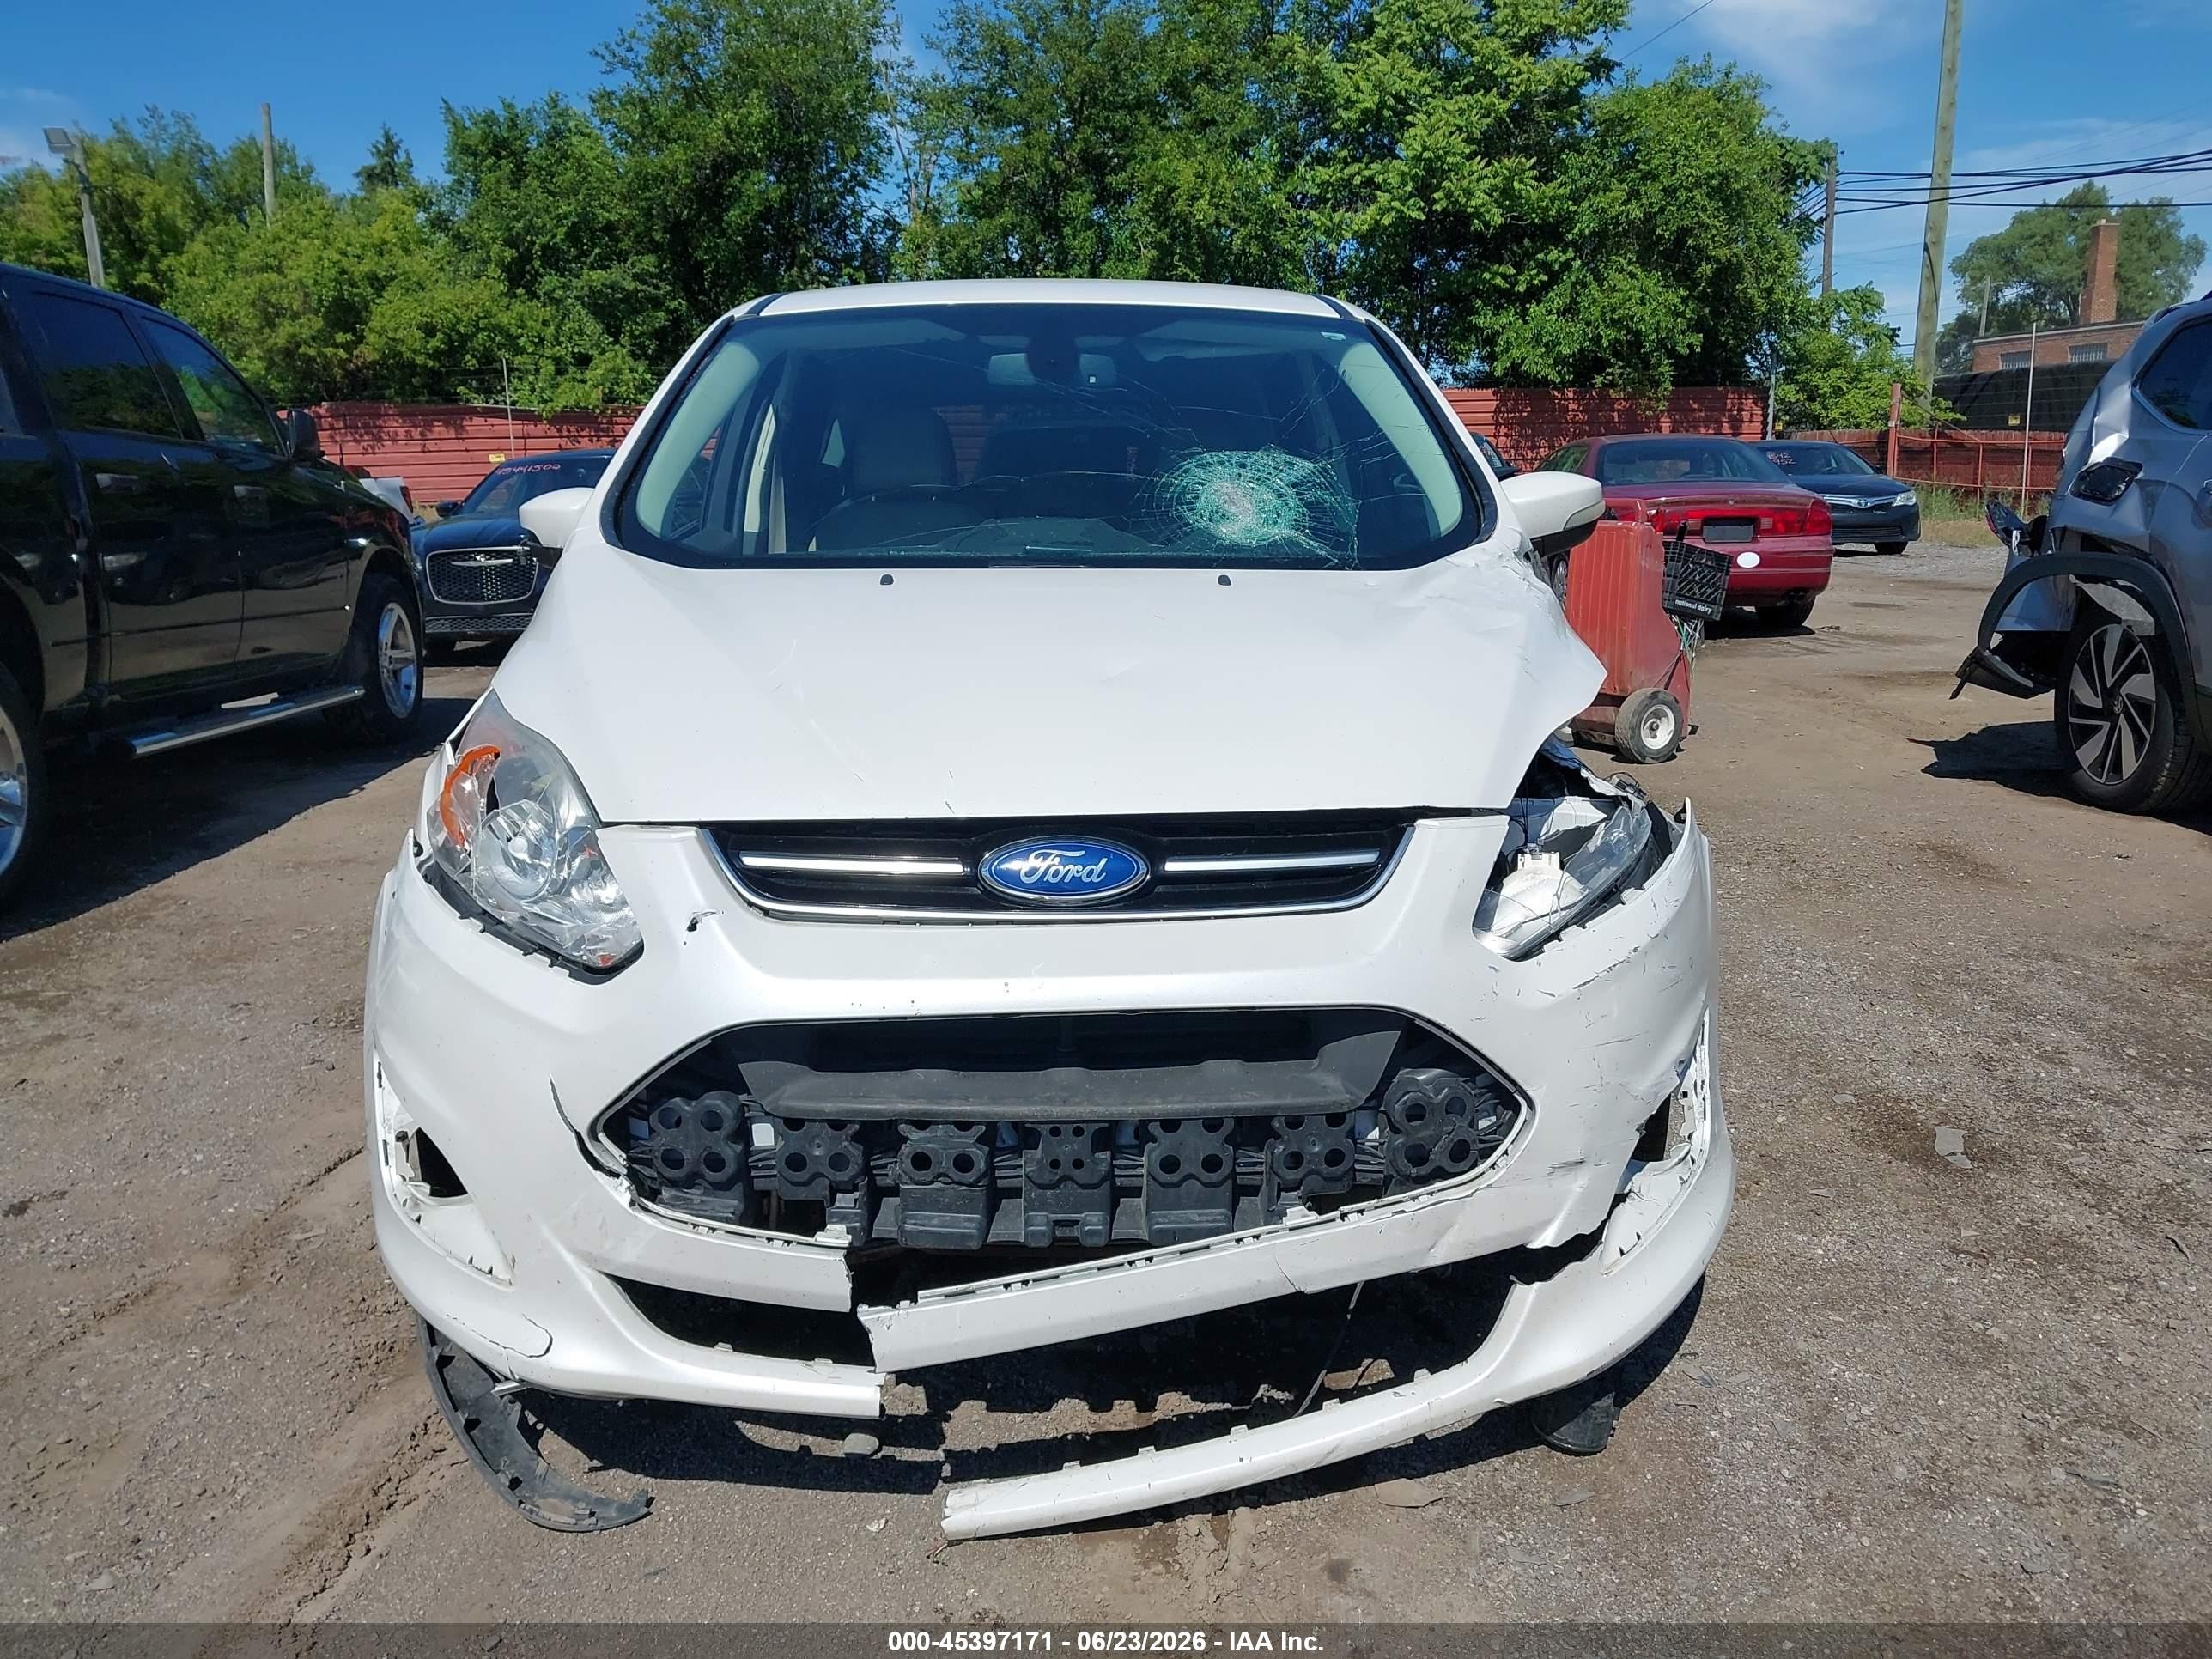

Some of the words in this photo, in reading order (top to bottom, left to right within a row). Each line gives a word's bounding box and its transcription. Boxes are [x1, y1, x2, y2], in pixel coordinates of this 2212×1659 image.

[1674, 599, 1698, 610] national
[1697, 604, 1713, 615] dairy
[1020, 848, 1108, 884] Ford
